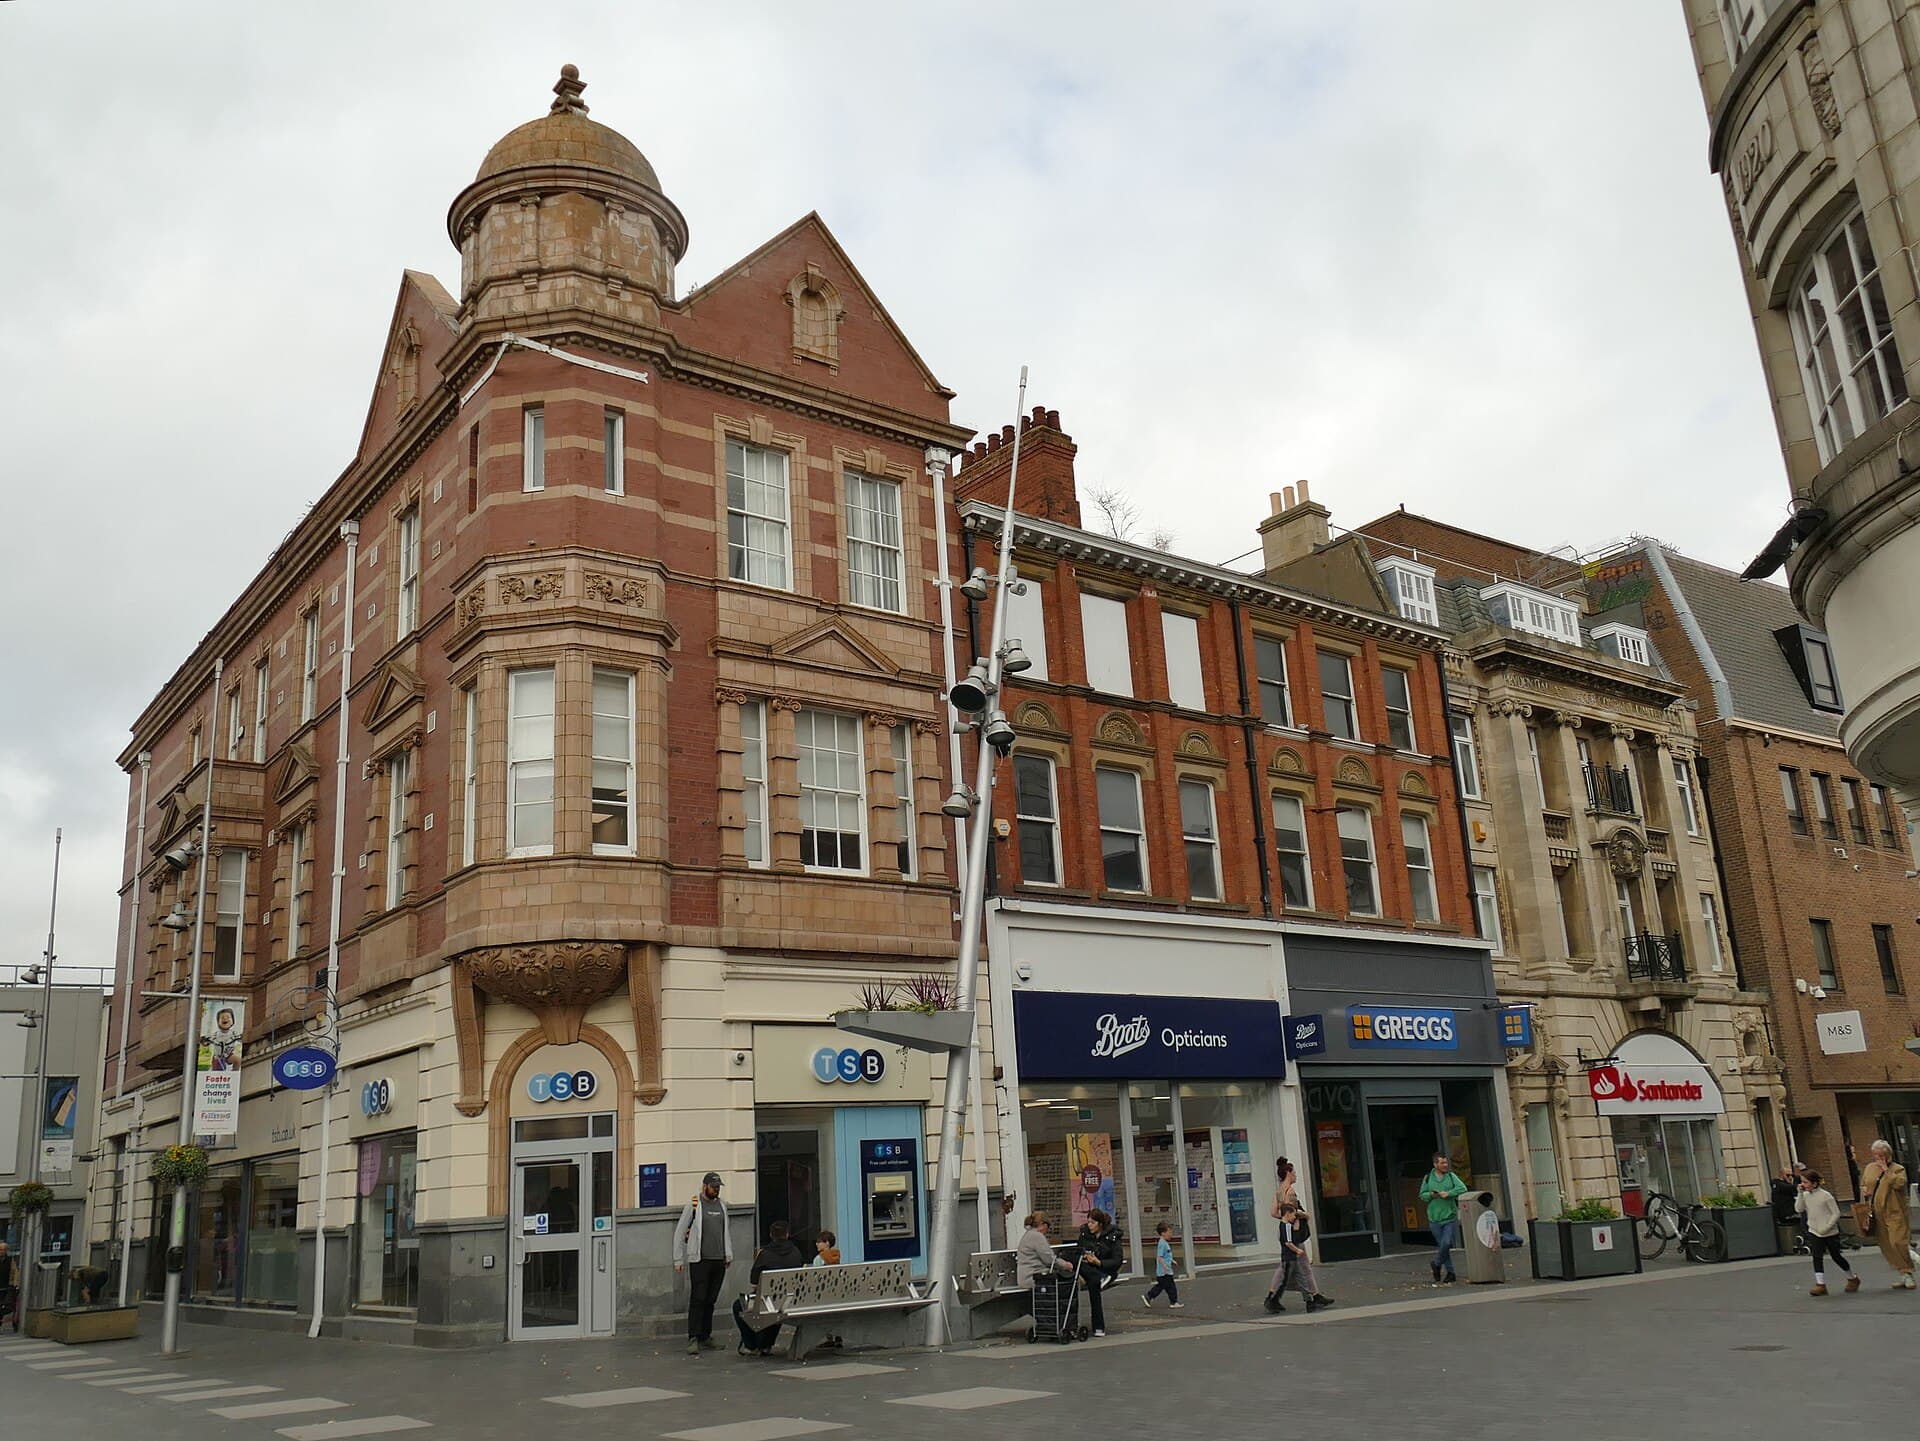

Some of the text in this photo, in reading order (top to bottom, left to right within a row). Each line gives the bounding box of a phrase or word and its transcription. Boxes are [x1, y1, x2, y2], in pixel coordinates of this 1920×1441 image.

[1736, 119, 1774, 205] 1920
[1091, 1013, 1227, 1058] Boots Opticians
[1295, 1022, 1316, 1040] Boots
[1374, 1015, 1453, 1041] GREGGS
[1827, 1024, 1852, 1036] M&S
[1295, 1041, 1318, 1050] Opticians
[286, 1062, 324, 1075] TSB
[818, 1053, 882, 1077] TSB
[205, 1075, 231, 1083] Foster
[533, 1074, 592, 1097] TSB
[202, 1090, 232, 1099] change
[363, 1082, 389, 1109] TSB
[1637, 1080, 1702, 1102] Santander
[875, 1145, 901, 1156] TSB
